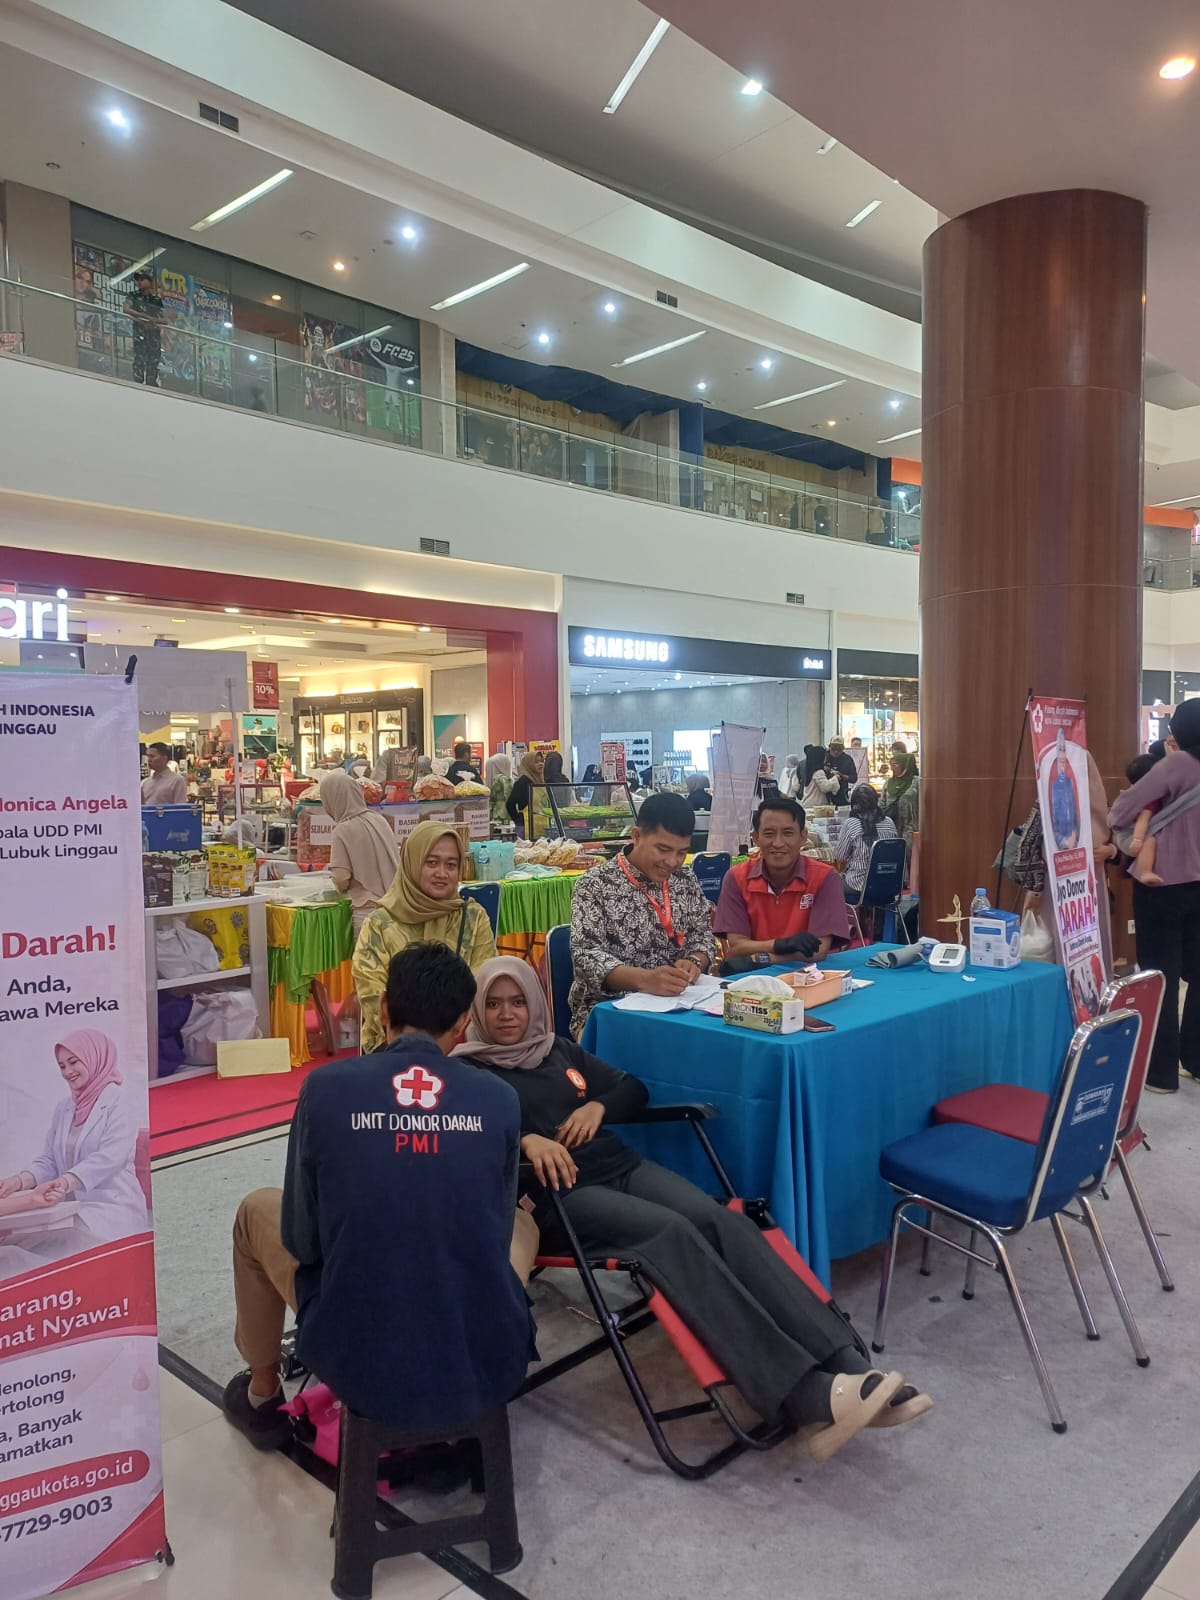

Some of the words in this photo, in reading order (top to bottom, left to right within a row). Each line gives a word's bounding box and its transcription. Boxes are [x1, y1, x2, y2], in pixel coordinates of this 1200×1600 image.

[161, 268, 187, 294] CTR
[583, 634, 669, 662] SAMSUNG
[255, 685, 275, 695] 10%
[10, 704, 95, 717] INDONESIA
[0, 796, 57, 812] onica
[62, 795, 128, 814] Angela
[33, 825, 69, 838] UDD
[74, 823, 102, 837] PMI
[0, 845, 51, 859] Lubuk
[55, 844, 118, 859] Linggau
[1066, 879, 1086, 898] Donor
[2, 925, 116, 959] Darah!
[7, 975, 71, 996] Anda,
[45, 996, 119, 1017] Mereka
[351, 1112, 386, 1130] UNIT
[389, 1113, 440, 1132] DONOR
[442, 1114, 483, 1132] DARAH
[395, 1133, 440, 1153] PMI
[0, 1289, 82, 1322] arang,
[42, 1298, 129, 1338] Nyawa!
[0, 1369, 76, 1396] enolong,
[0, 1389, 65, 1415] rtolong
[18, 1408, 83, 1438] Banyak
[0, 1434, 73, 1463] amatkan
[0, 1456, 133, 1511] ggaukota.go.id
[0, 1495, 113, 1543] 7729-9003
